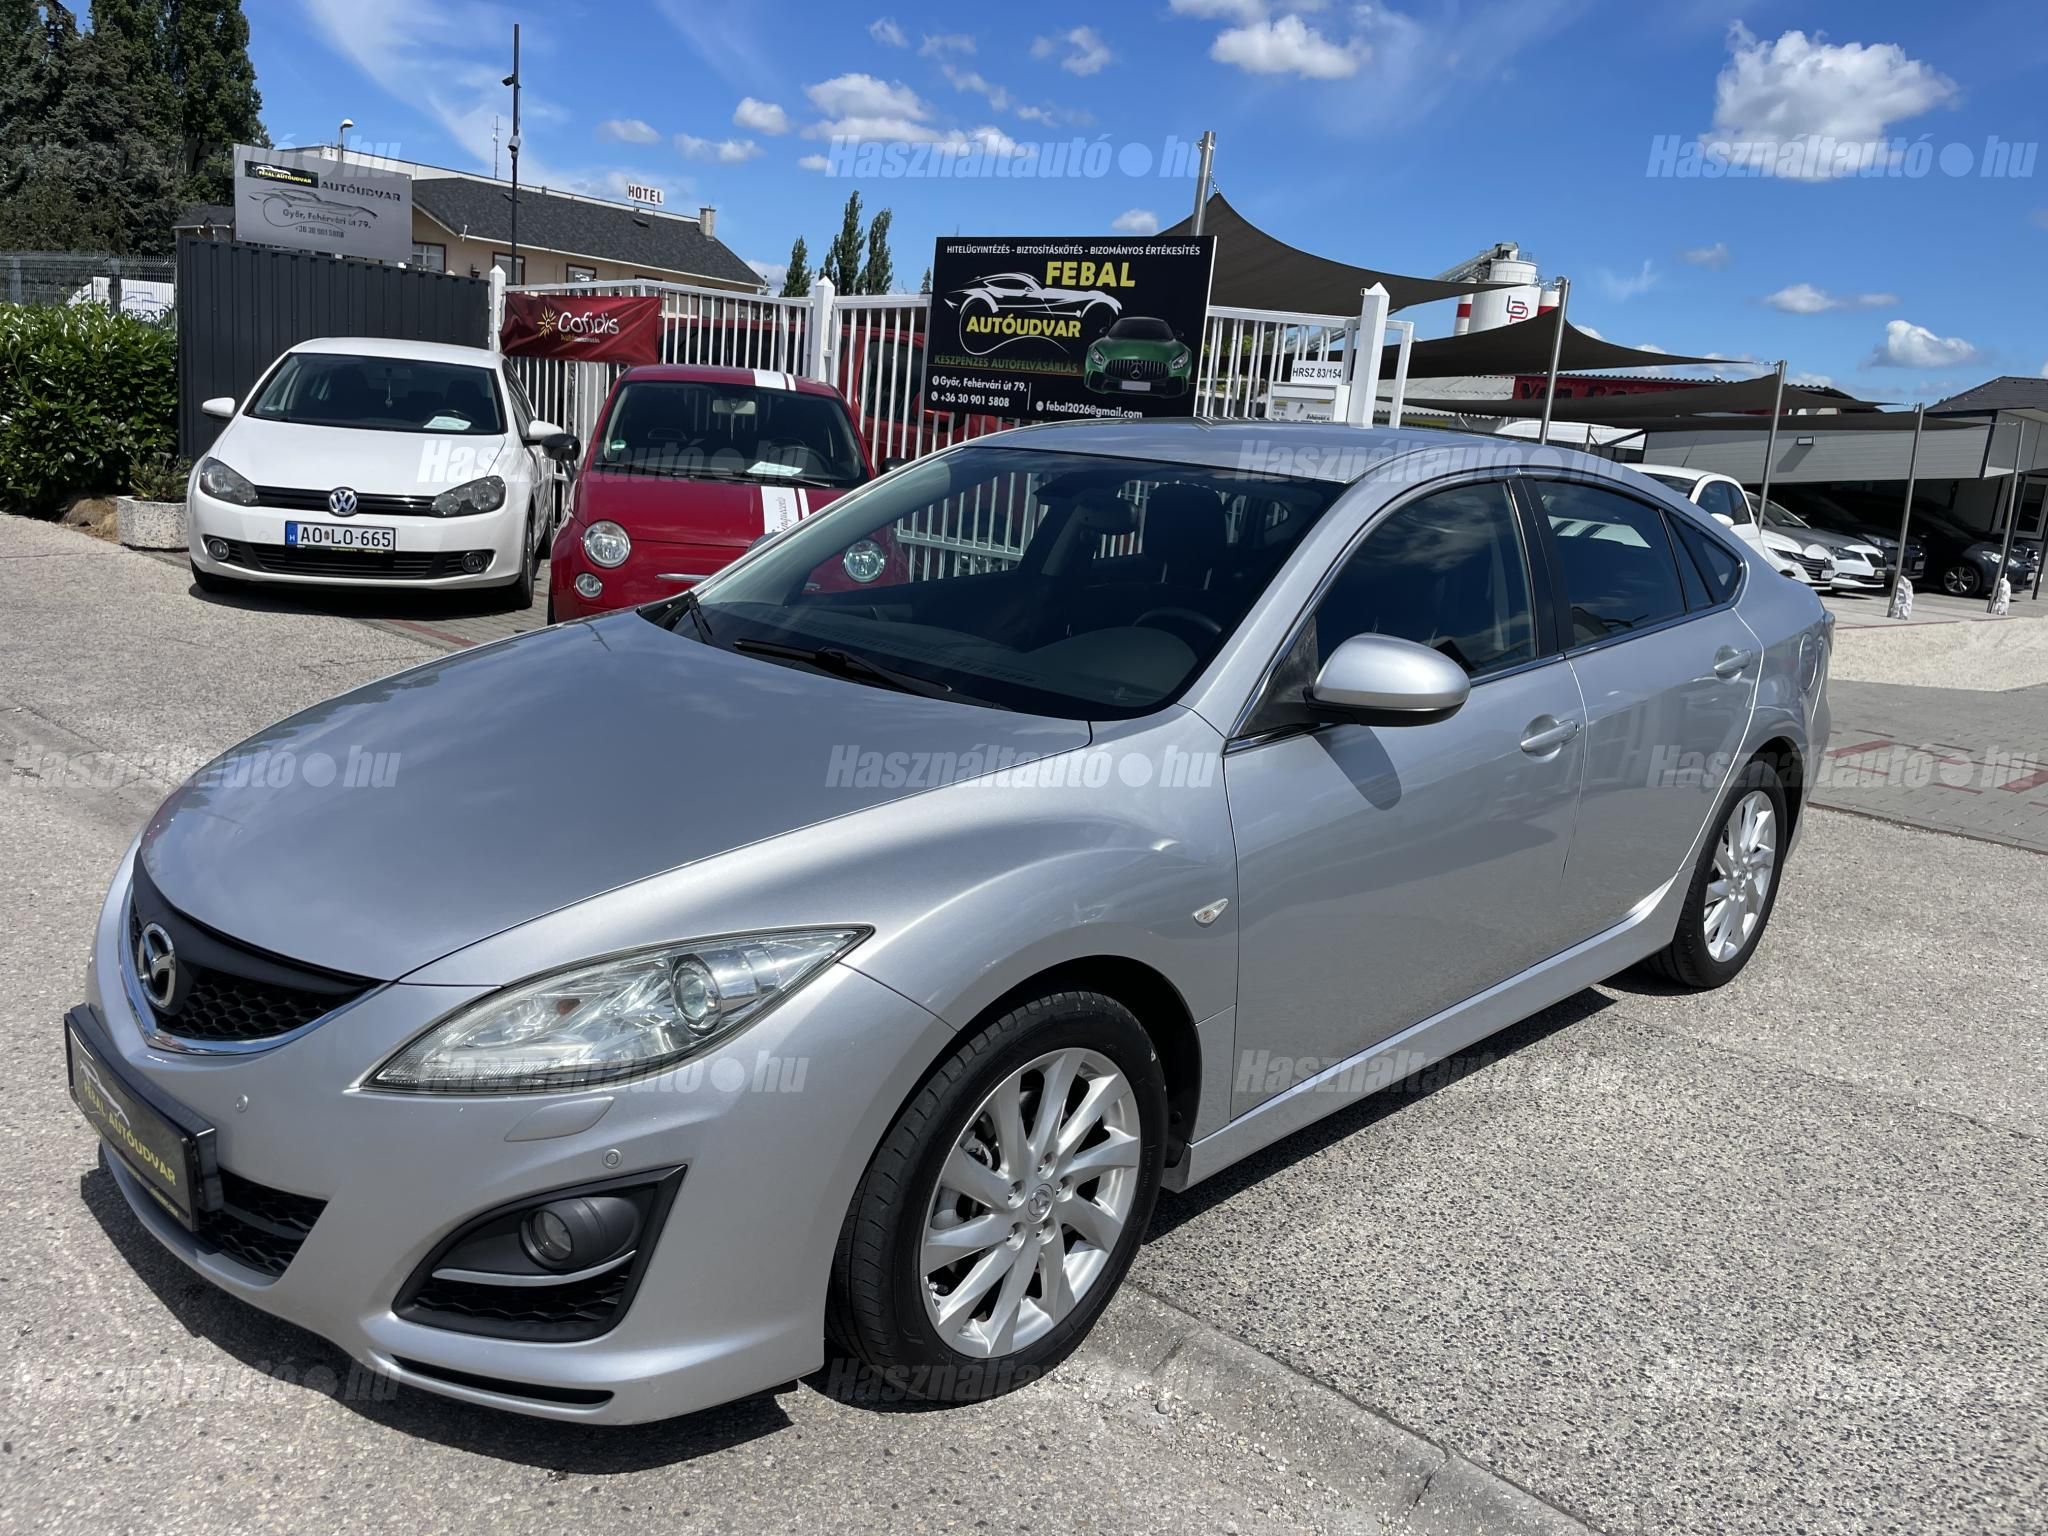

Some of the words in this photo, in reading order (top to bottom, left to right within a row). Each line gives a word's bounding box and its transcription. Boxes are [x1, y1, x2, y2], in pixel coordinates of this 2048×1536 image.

[320, 180, 401, 202] AUTÓUDVAR
[628, 185, 663, 203] HOTEL
[946, 244, 1011, 254] HITELÜGYINTÉZÉS
[1016, 244, 1083, 255] BIZTOSÍTÁSKÖTÉS
[1090, 244, 1144, 255] BIZOMÁNYOS
[1145, 244, 1200, 256] ÉRTÉKESÍTÉS
[1045, 261, 1136, 288] FEBAL
[558, 311, 619, 335] Cofidis
[966, 313, 1081, 338] AUTÓUDVAR
[1292, 367, 1315, 378] HRSZ
[1316, 368, 1342, 379] 83/154
[940, 375, 961, 388] Győr,
[963, 377, 1001, 390] Fehérvári
[1003, 380, 1012, 391] út
[1013, 381, 1027, 392] 79.
[940, 392, 956, 402] +36
[957, 393, 968, 404] 30
[970, 394, 985, 405] 901
[988, 396, 1010, 407] 5808
[1046, 401, 1143, 419] febal2026@gmail.com
[108, 1111, 177, 1187] AUTÓUDVAR
